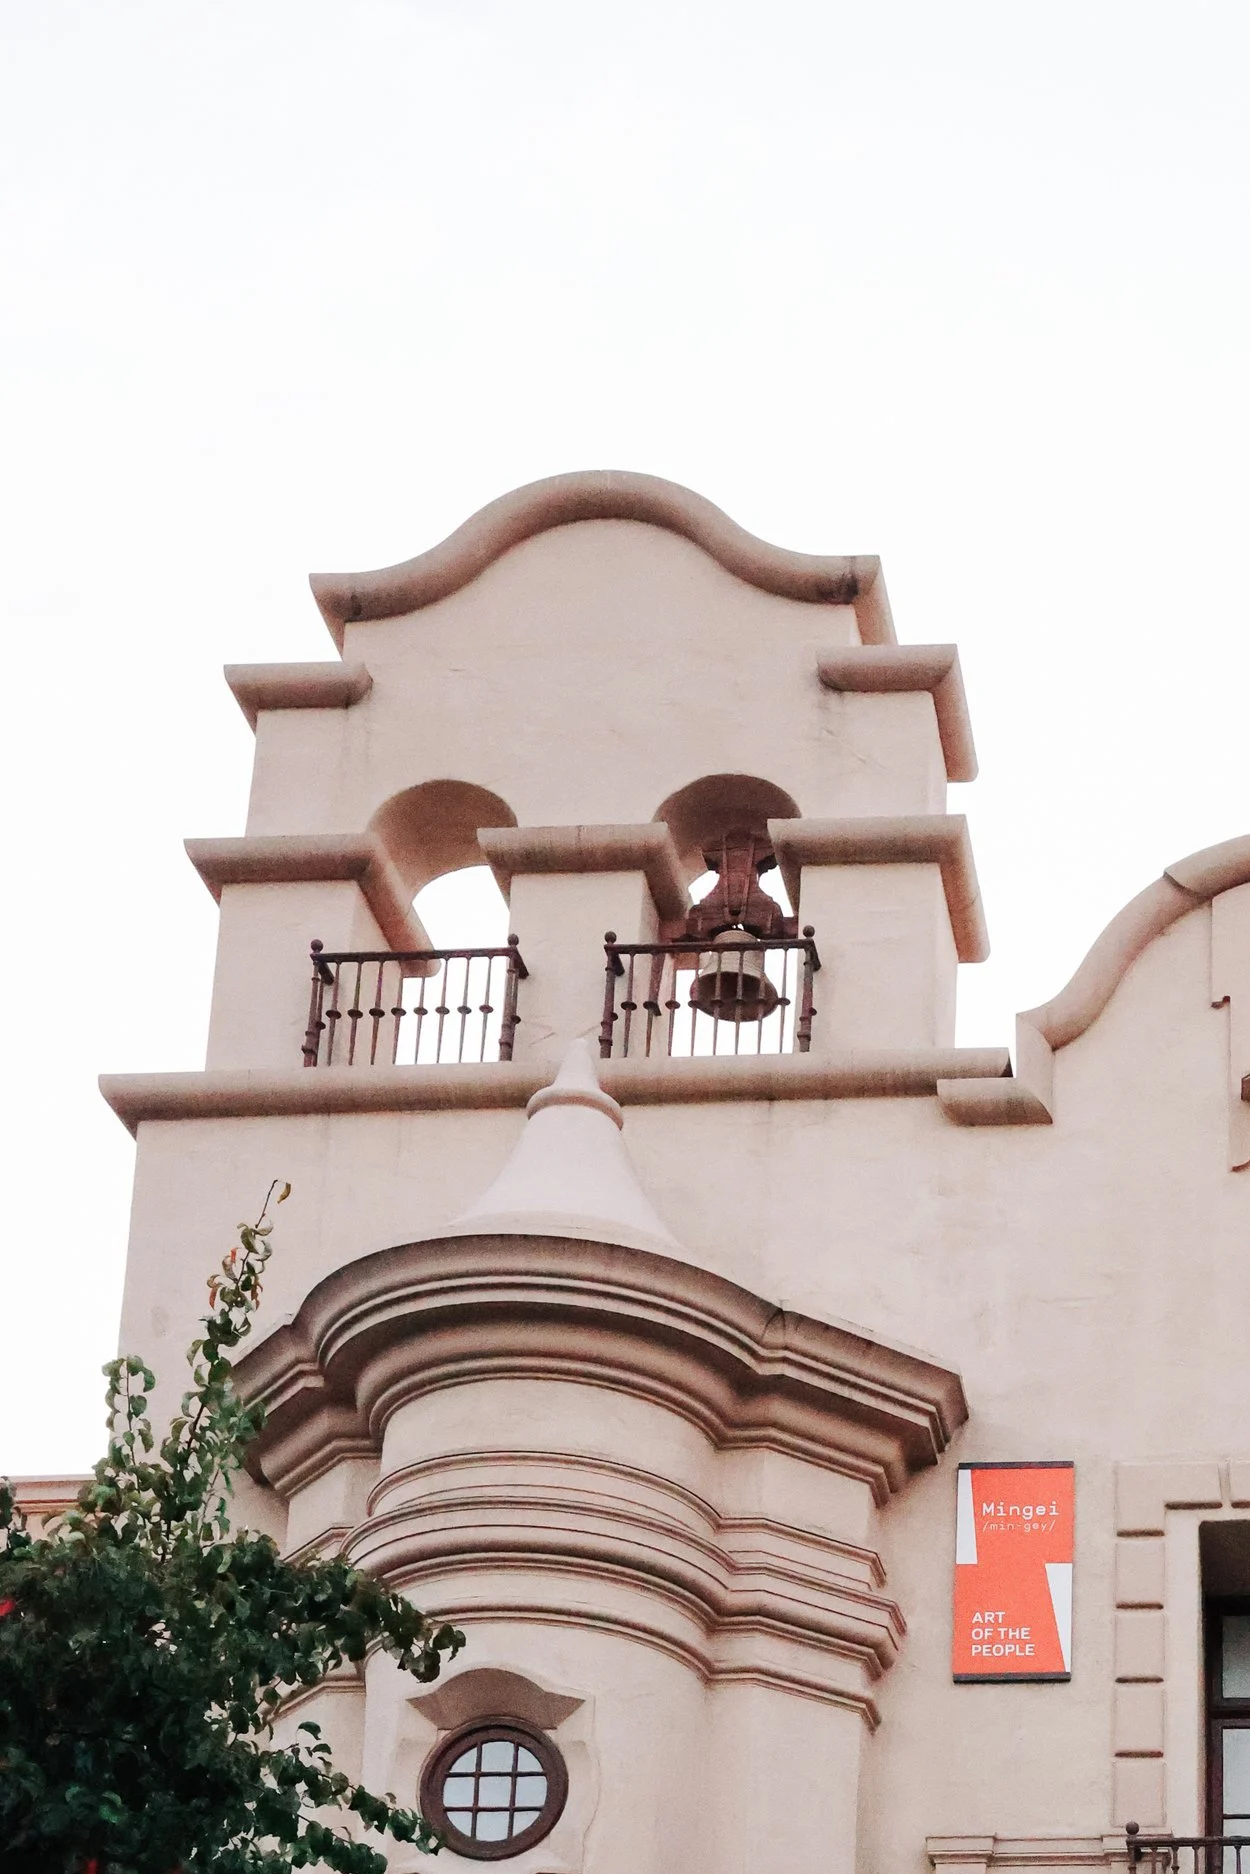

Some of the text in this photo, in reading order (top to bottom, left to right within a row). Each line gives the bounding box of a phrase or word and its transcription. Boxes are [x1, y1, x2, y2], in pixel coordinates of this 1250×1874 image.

[982, 1501, 1060, 1520] Mingei
[972, 1611, 1006, 1624] ART
[971, 1627, 1031, 1640] OF THE
[971, 1643, 1035, 1657] PEOPLE
